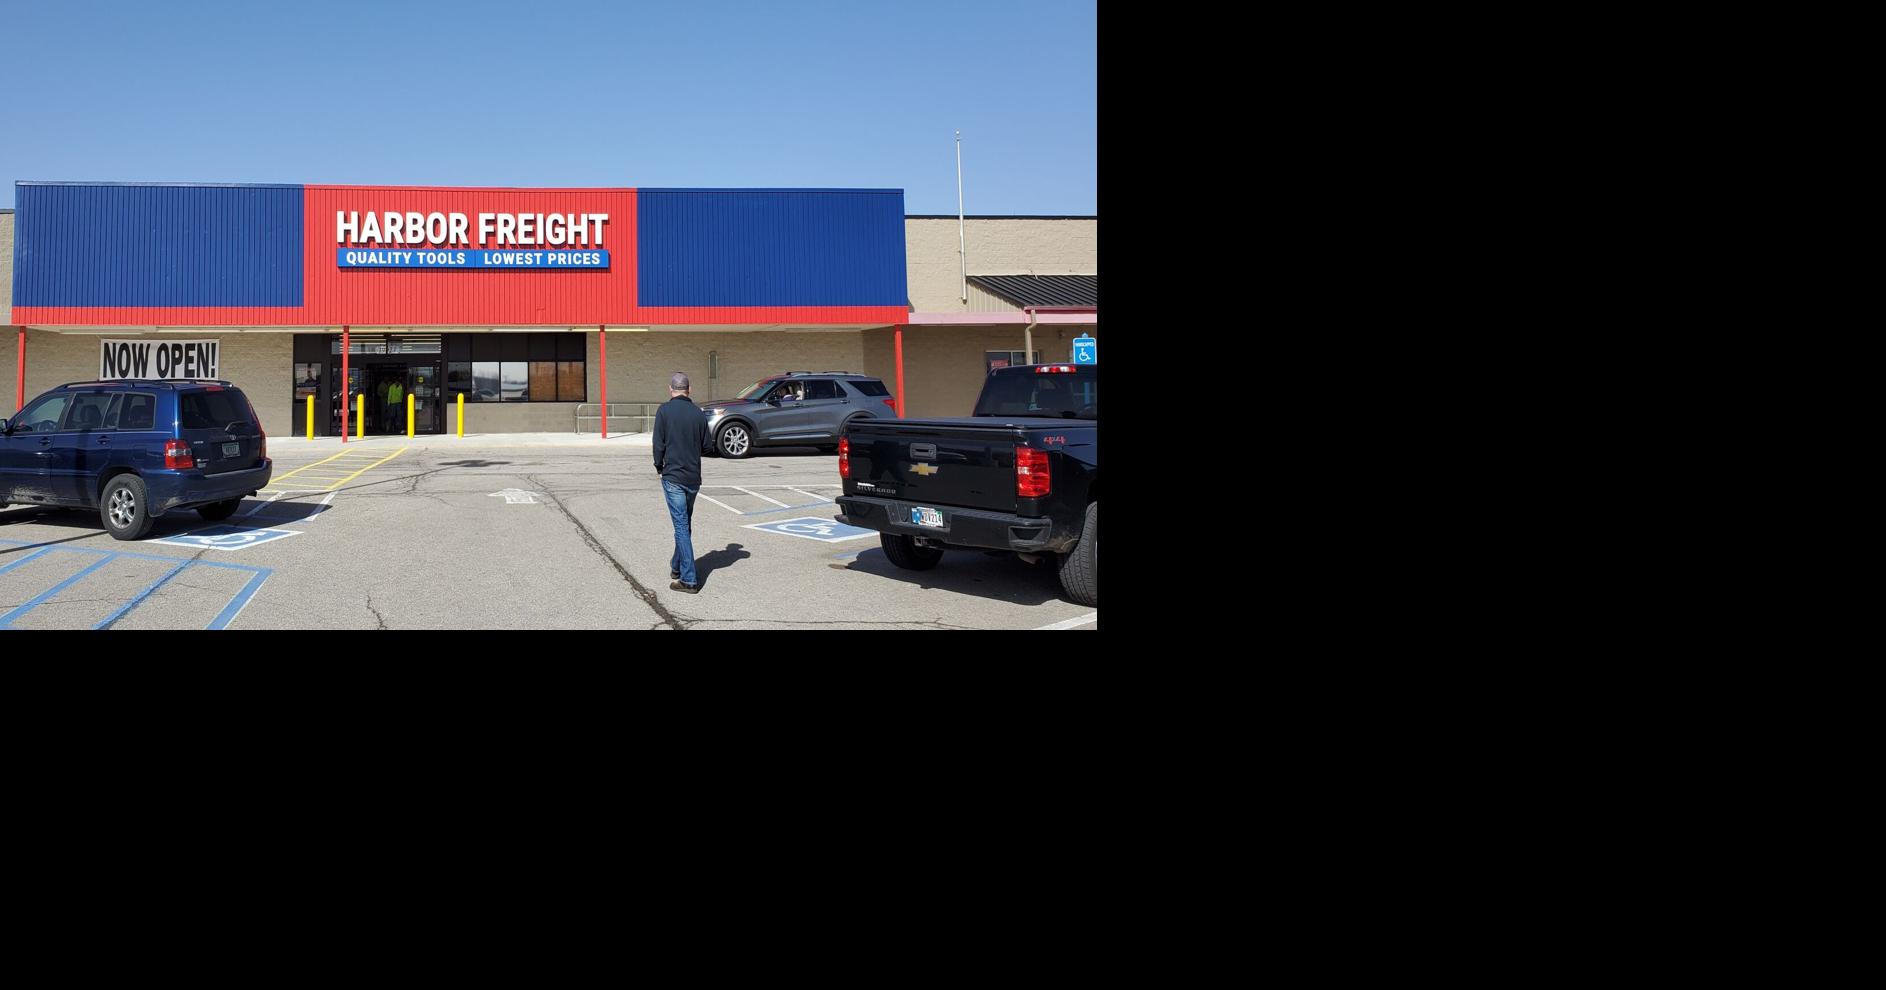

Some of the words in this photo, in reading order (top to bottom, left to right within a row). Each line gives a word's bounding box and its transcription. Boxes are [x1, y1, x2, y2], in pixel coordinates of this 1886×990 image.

[337, 211, 469, 244] HARBOR
[478, 212, 608, 245] FREIGHT
[346, 252, 412, 265] QUALITY
[416, 252, 466, 265] TOOLS
[484, 252, 543, 265] LOWEST
[547, 252, 600, 265] PRICES
[102, 342, 151, 379] NOW
[156, 342, 217, 379] OPEN!
